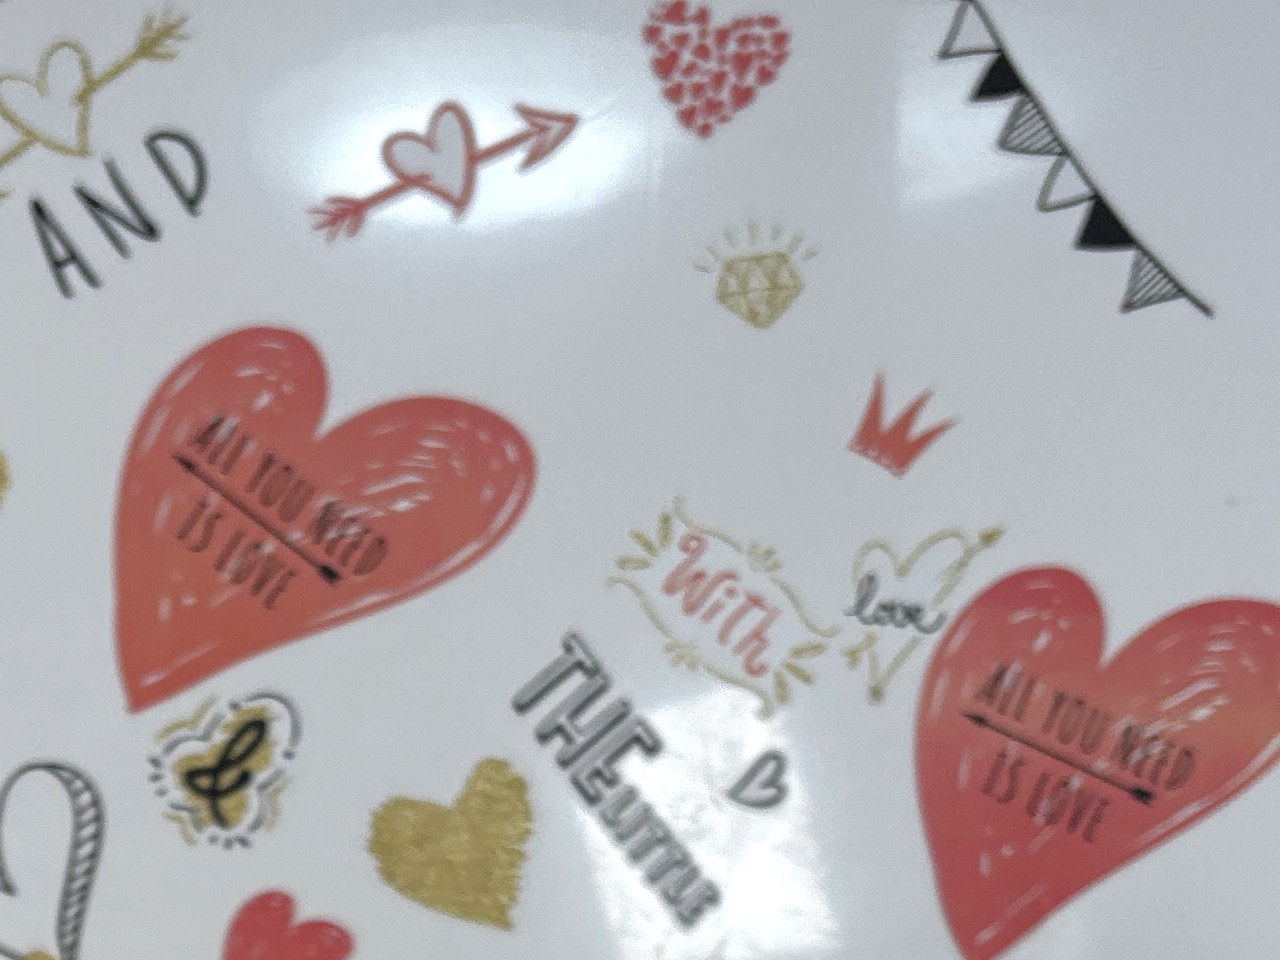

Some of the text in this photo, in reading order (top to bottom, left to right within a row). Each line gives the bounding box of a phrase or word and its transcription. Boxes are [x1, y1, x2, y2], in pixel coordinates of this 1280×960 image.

[28, 125, 208, 299] AND
[246, 451, 315, 525] YOU
[511, 629, 664, 808] THE
[1042, 690, 1110, 755] YOU
